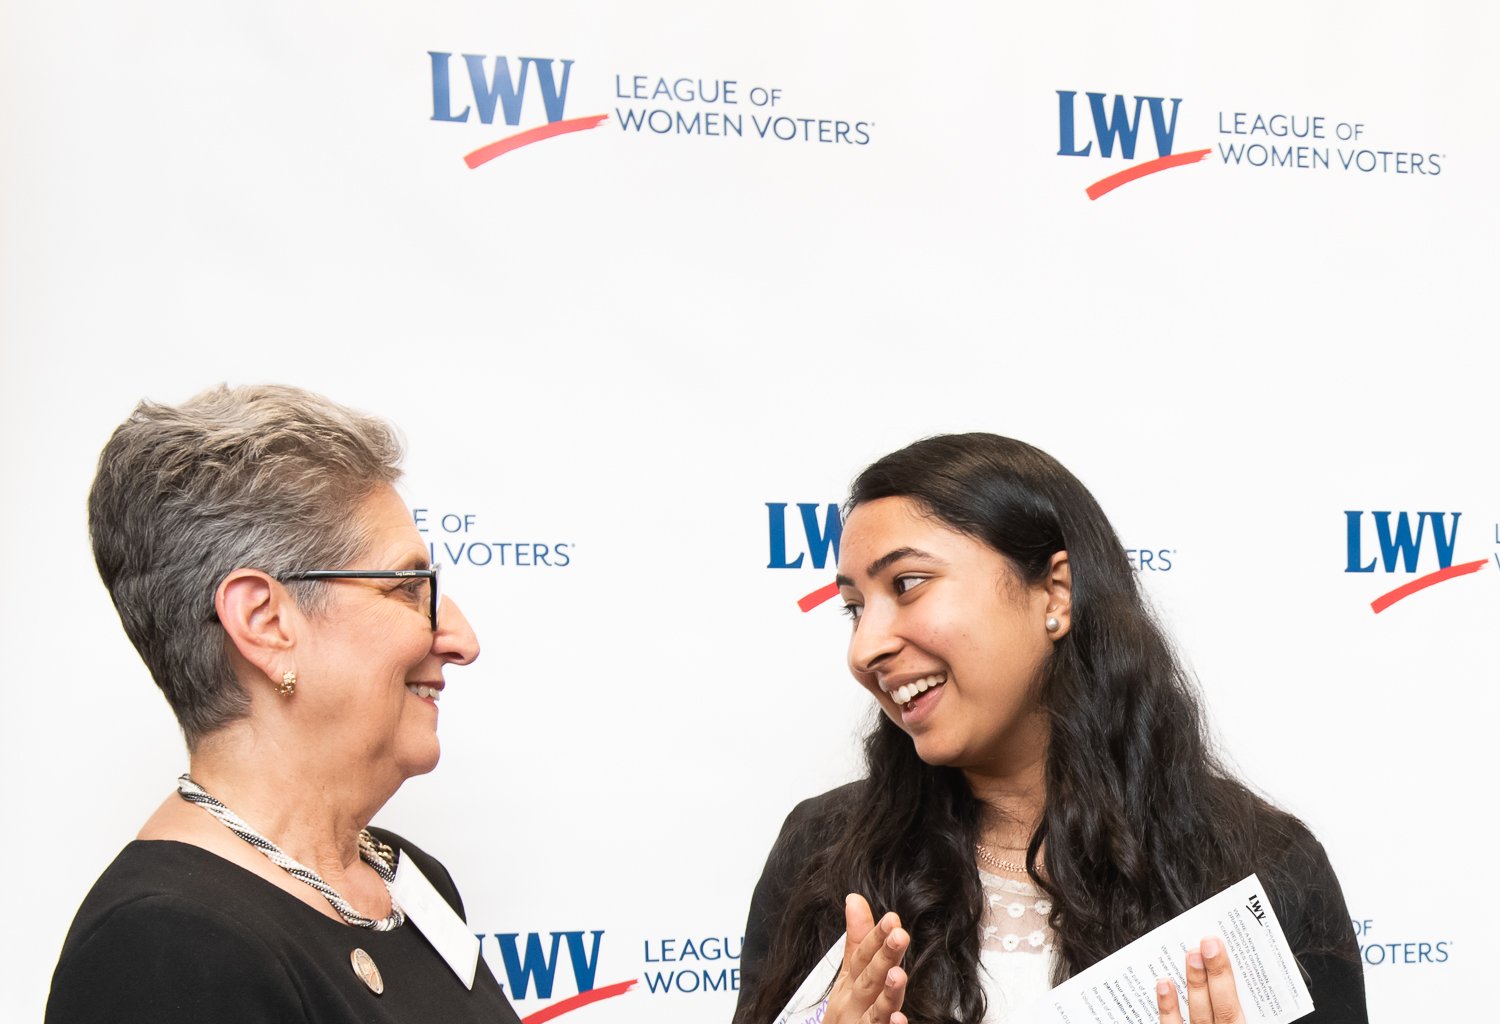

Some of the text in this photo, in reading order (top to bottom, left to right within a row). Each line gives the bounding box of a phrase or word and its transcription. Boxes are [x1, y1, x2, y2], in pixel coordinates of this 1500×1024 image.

[427, 51, 577, 127] LWV
[616, 75, 782, 106] LEAGUE OF
[616, 108, 870, 145] WOMEN VOTERS
[1056, 90, 1184, 161] LWV
[1219, 112, 1364, 140] LEAGUE OF
[1218, 143, 1440, 175] WOMEN VOTERS
[441, 514, 475, 533] OF
[765, 502, 844, 569] LW
[444, 543, 571, 567] VOTERS
[1344, 510, 1463, 574] LWV
[1248, 894, 1265, 921] LWV
[476, 930, 606, 1001] WV
[645, 936, 745, 963] LEAGU
[1360, 942, 1449, 966] OTERS
[644, 968, 743, 995] WOME
[1102, 980, 1127, 1015] participation
[1124, 1014, 1134, 1024] will
[1113, 979, 1124, 993] Your
[1121, 993, 1133, 1008] voice
[1130, 1008, 1139, 1018] will
